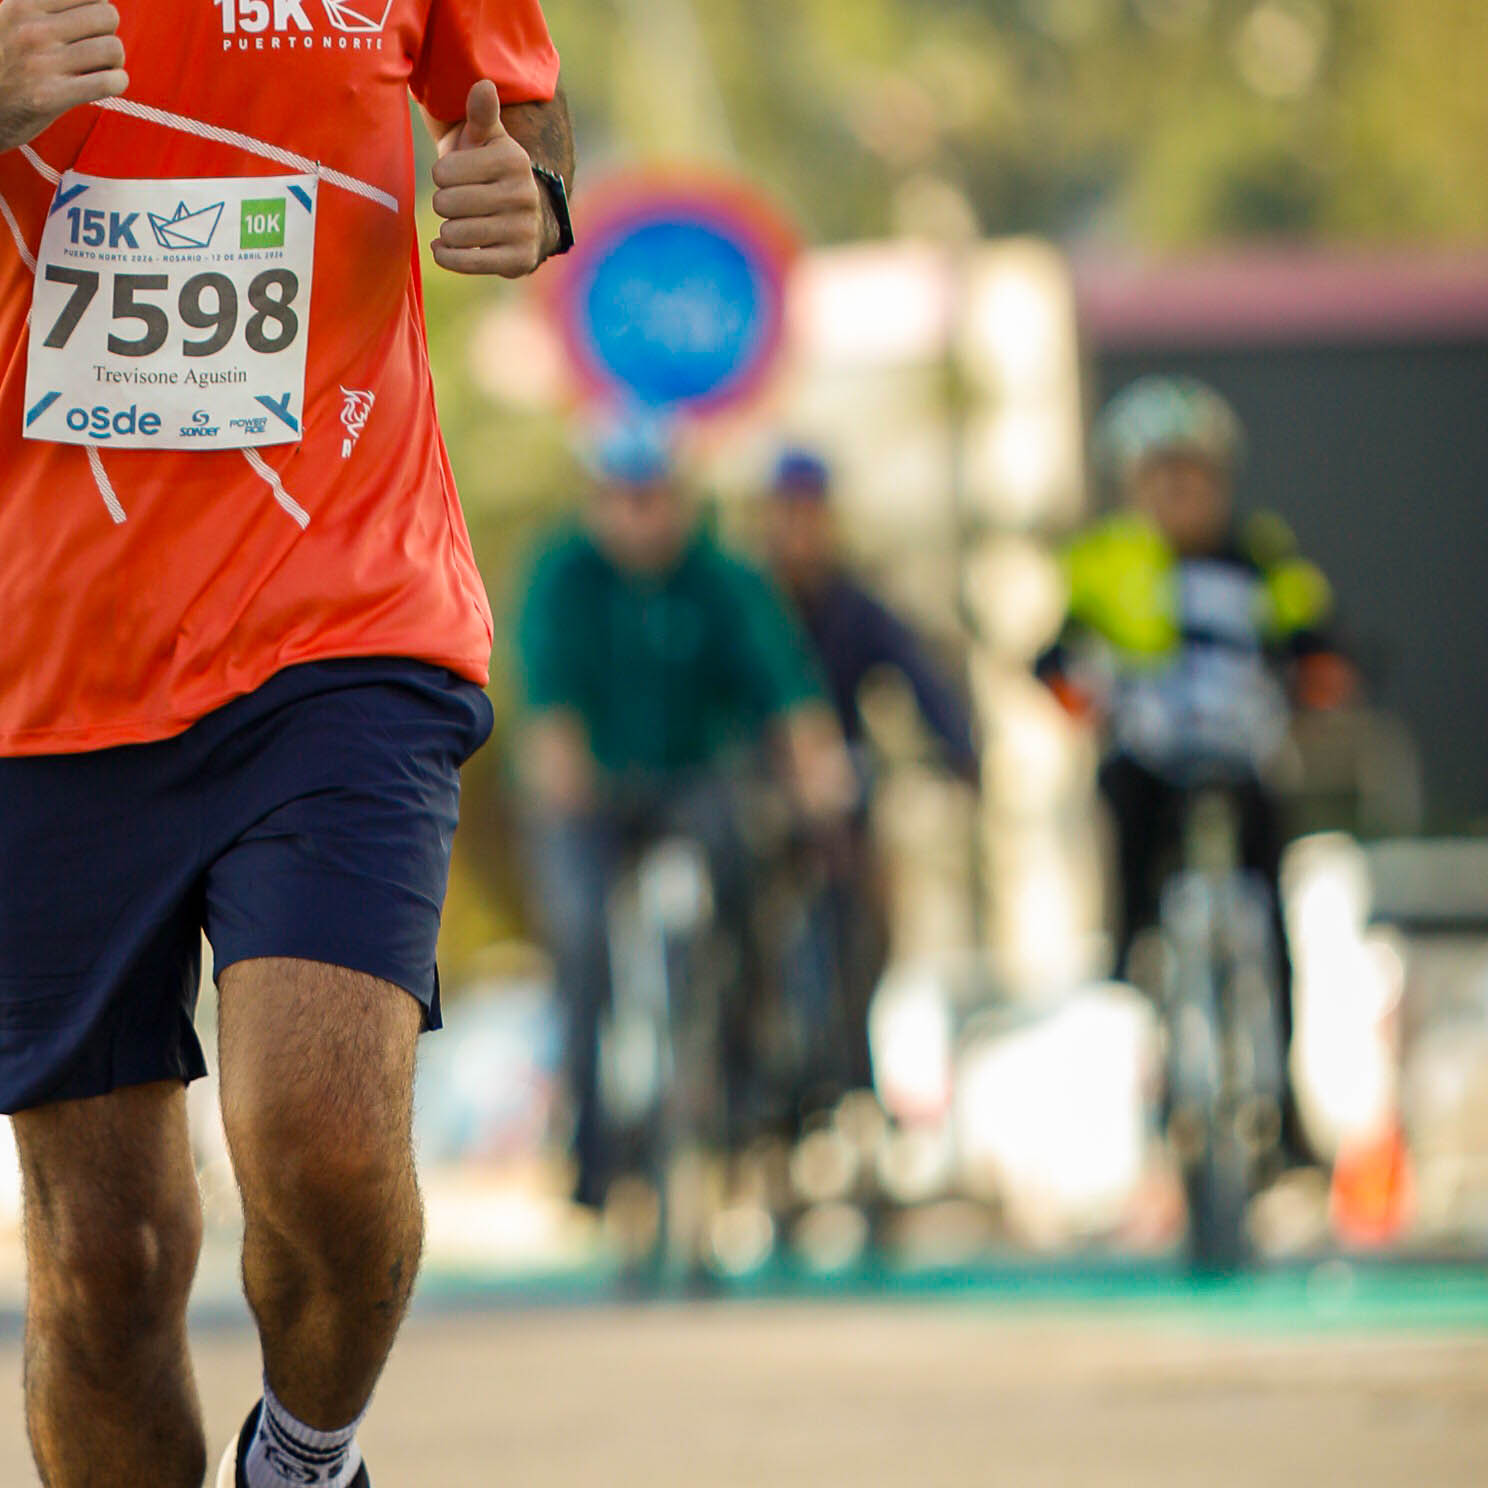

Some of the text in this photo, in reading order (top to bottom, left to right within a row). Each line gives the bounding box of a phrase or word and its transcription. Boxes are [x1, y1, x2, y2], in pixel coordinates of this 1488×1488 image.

[224, 36, 383, 51] PUERTO NORTE
[67, 206, 140, 248] 15K
[245, 213, 281, 234] 10K
[64, 248, 96, 259] PUERTO
[99, 253, 128, 262] NORTE
[163, 254, 202, 262] ROSARIO
[224, 253, 234, 261] DE
[238, 252, 261, 261] ABRIL
[43, 264, 299, 358] 7598
[93, 365, 247, 388] Trevisone Agustin
[66, 404, 162, 439] osde
